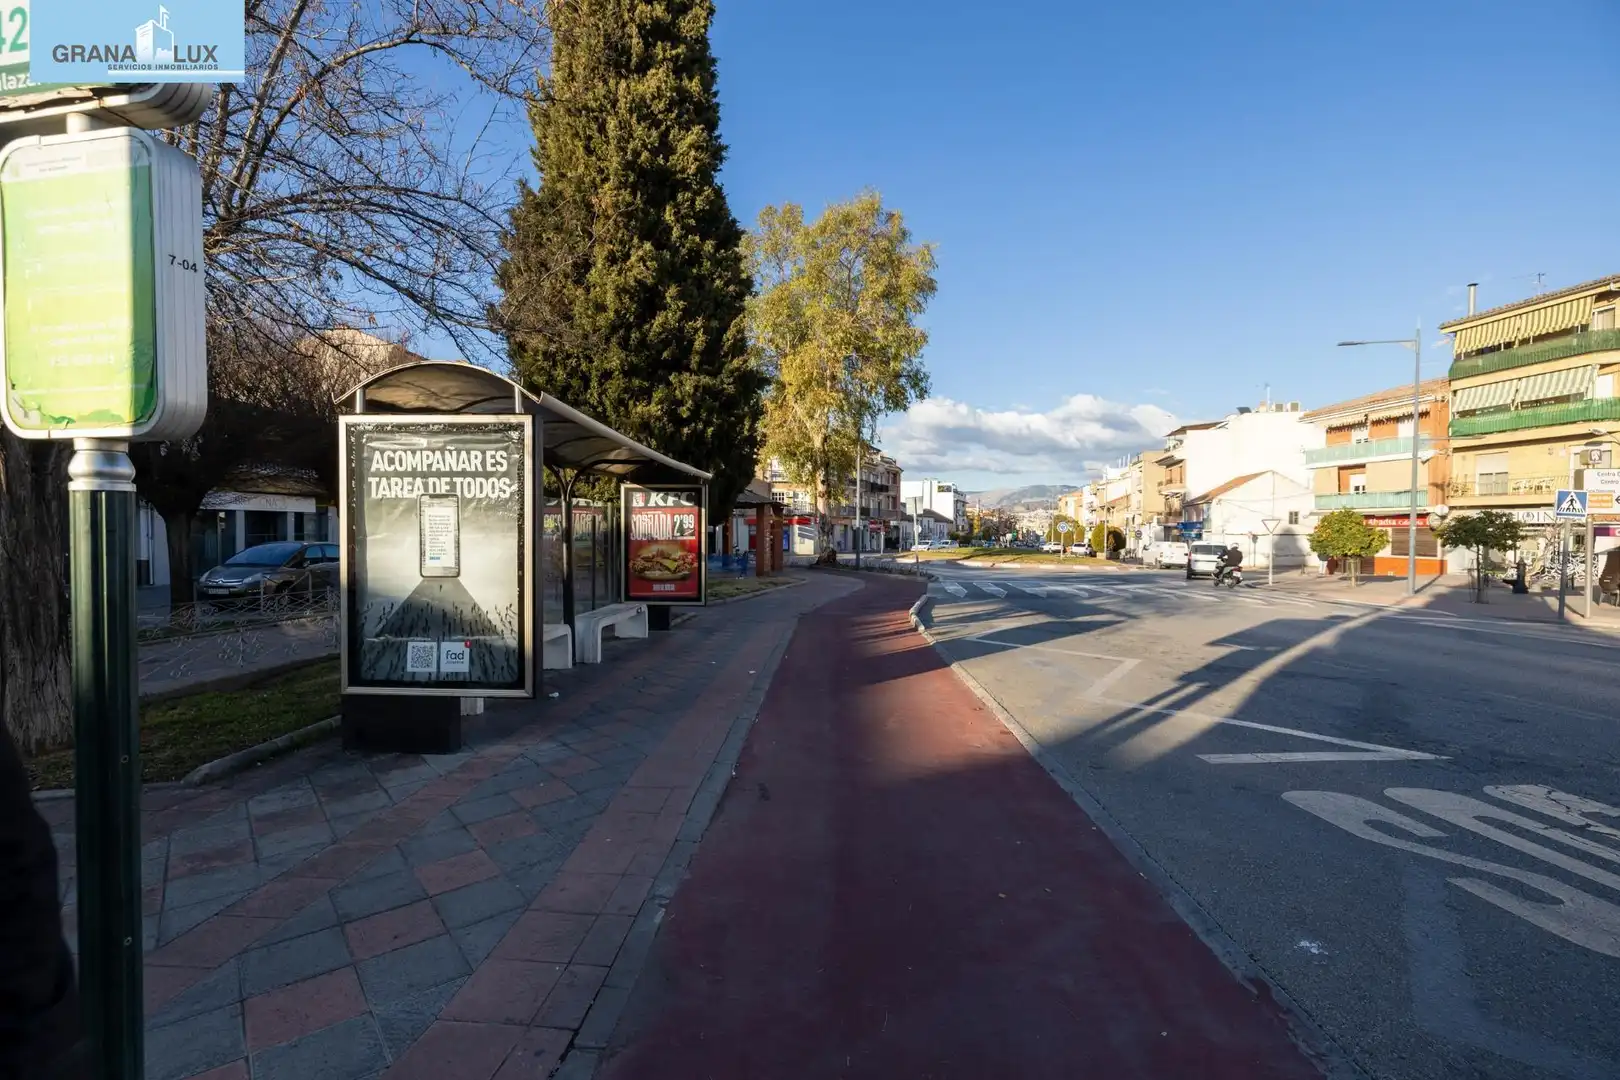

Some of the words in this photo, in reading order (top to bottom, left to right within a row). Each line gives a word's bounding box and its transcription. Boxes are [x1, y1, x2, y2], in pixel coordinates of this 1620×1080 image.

[168, 254, 198, 273] 7-04
[371, 446, 483, 472] ACOMPAÑAR
[486, 450, 508, 472] ES
[368, 477, 425, 499] TAREA
[428, 477, 451, 495] DE
[453, 477, 511, 499] TODOS
[648, 491, 695, 507] KFC
[446, 649, 465, 660] fad
